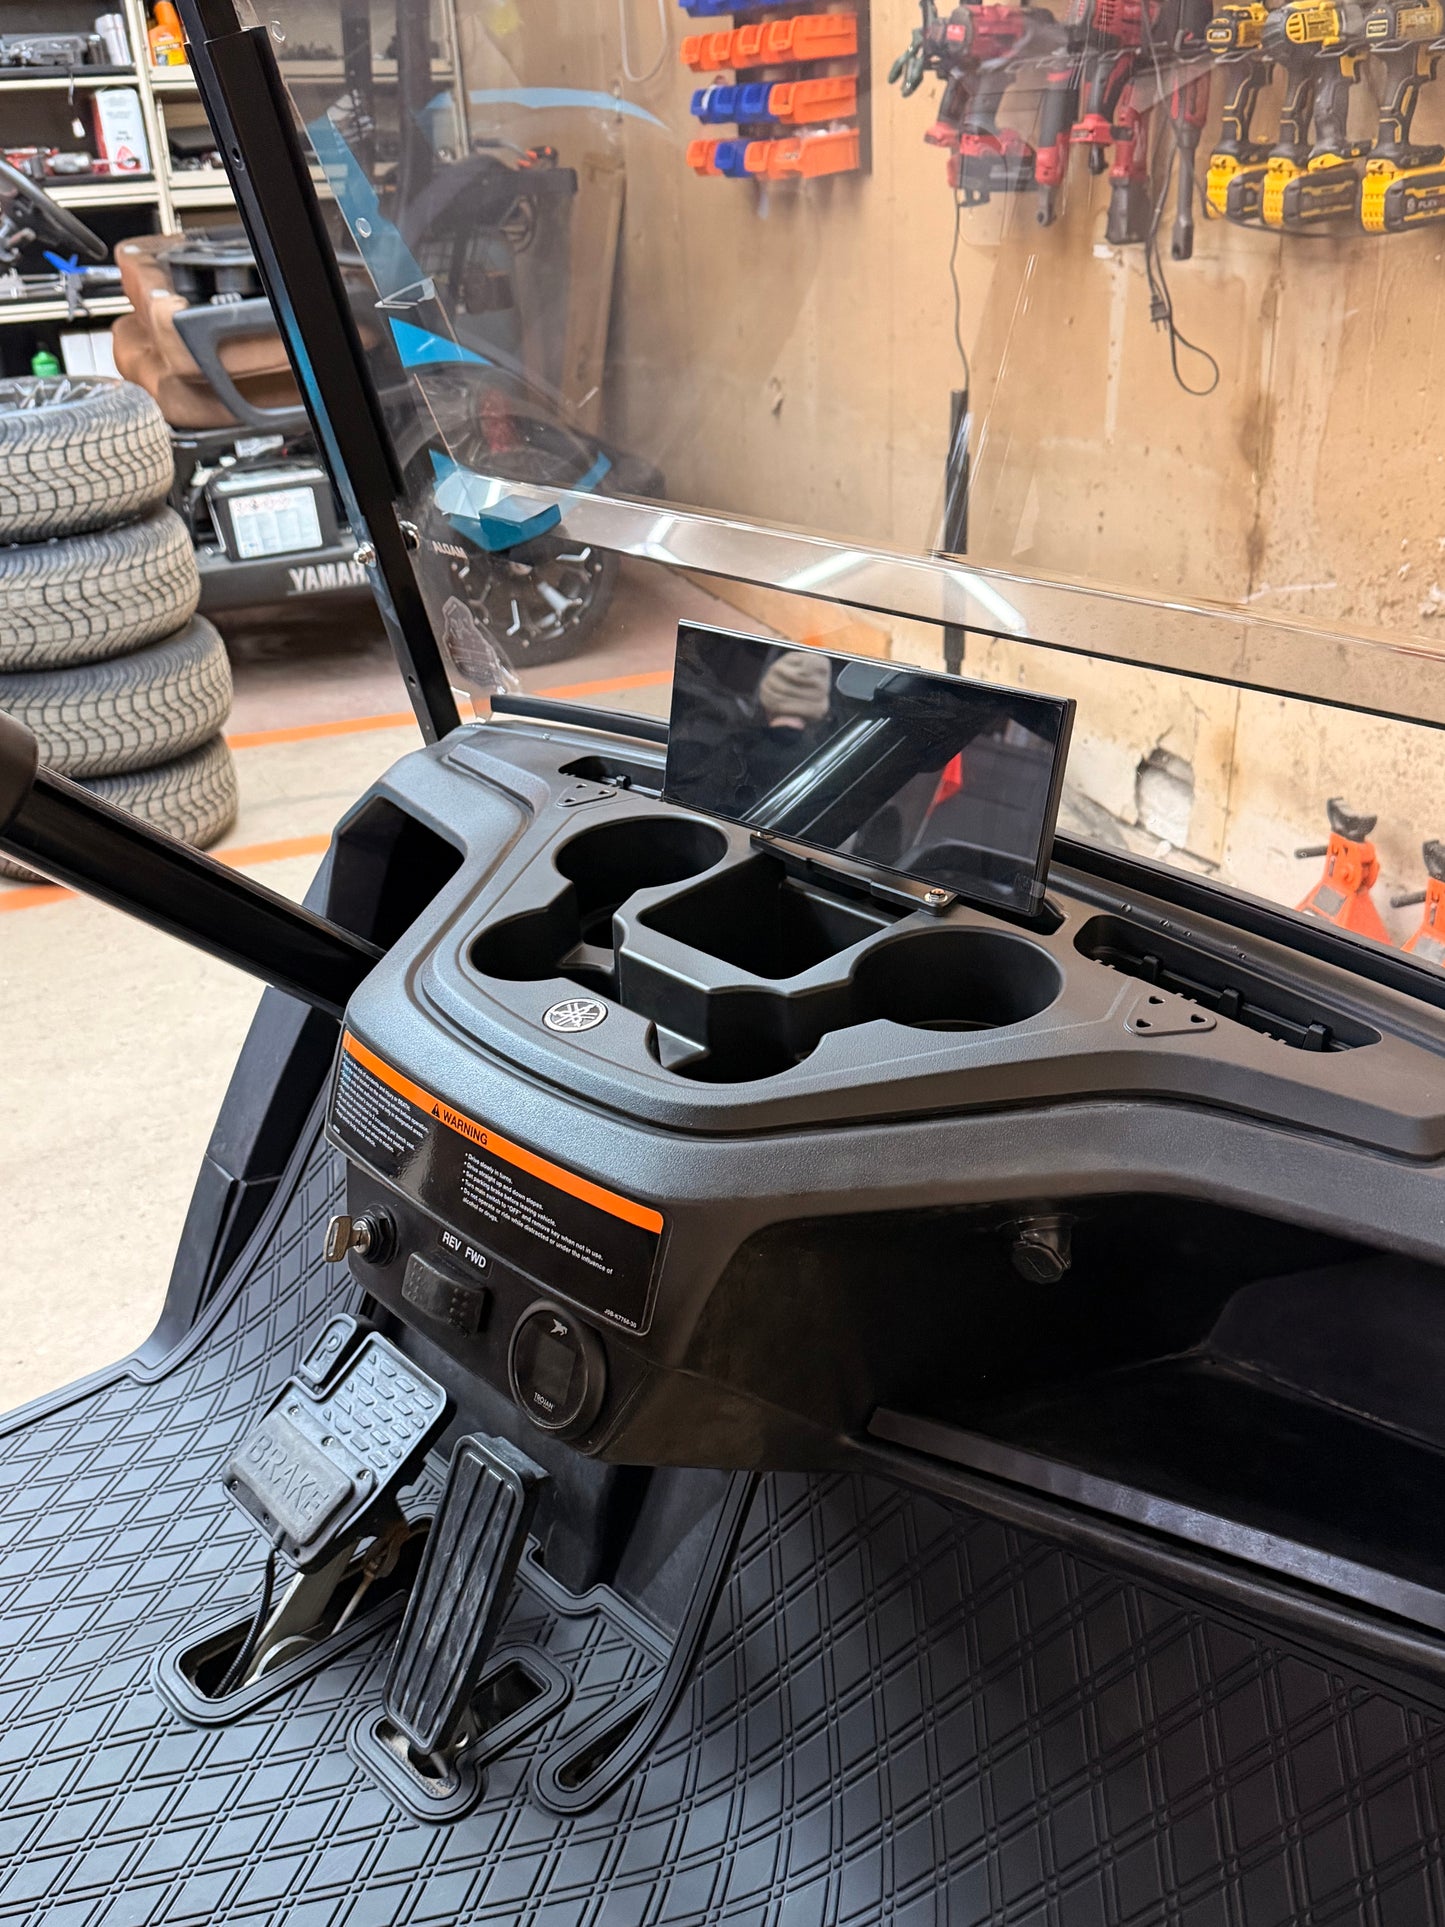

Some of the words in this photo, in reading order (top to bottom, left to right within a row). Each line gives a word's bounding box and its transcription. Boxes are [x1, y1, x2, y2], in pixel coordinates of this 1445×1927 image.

[288, 560, 371, 592] YAMAH
[443, 1109, 488, 1146] WARNING
[466, 1161, 478, 1173] Drive
[478, 1169, 495, 1184] straight
[502, 1183, 511, 1192] and
[512, 1188, 525, 1200] down
[526, 1196, 543, 1211] slopes.
[467, 1153, 479, 1164] Drive
[479, 1160, 494, 1174] slowly
[499, 1172, 513, 1184] turns.
[462, 1196, 478, 1209] alcohol
[483, 1209, 498, 1223] drugs.
[465, 1179, 474, 1189] Turn
[486, 1192, 500, 1204] switch
[521, 1212, 531, 1222] and
[531, 1219, 549, 1233] remove
[550, 1228, 560, 1239] key
[560, 1233, 575, 1246] when
[575, 1241, 585, 1251] not
[591, 1250, 603, 1260] use.
[473, 1176, 489, 1191] parking
[490, 1185, 503, 1197] brake
[503, 1193, 519, 1206] before
[519, 1202, 536, 1217] leaving
[537, 1211, 556, 1226] vehicle.
[442, 1231, 462, 1251] REV
[465, 1246, 486, 1268] FWD
[477, 1197, 495, 1211] operate
[500, 1210, 510, 1219] ride
[510, 1215, 523, 1227] while
[523, 1223, 549, 1241] distracted
[555, 1240, 571, 1253] under
[571, 1249, 580, 1258] the
[580, 1254, 605, 1272] influence
[247, 1434, 331, 1522] BRAKE
